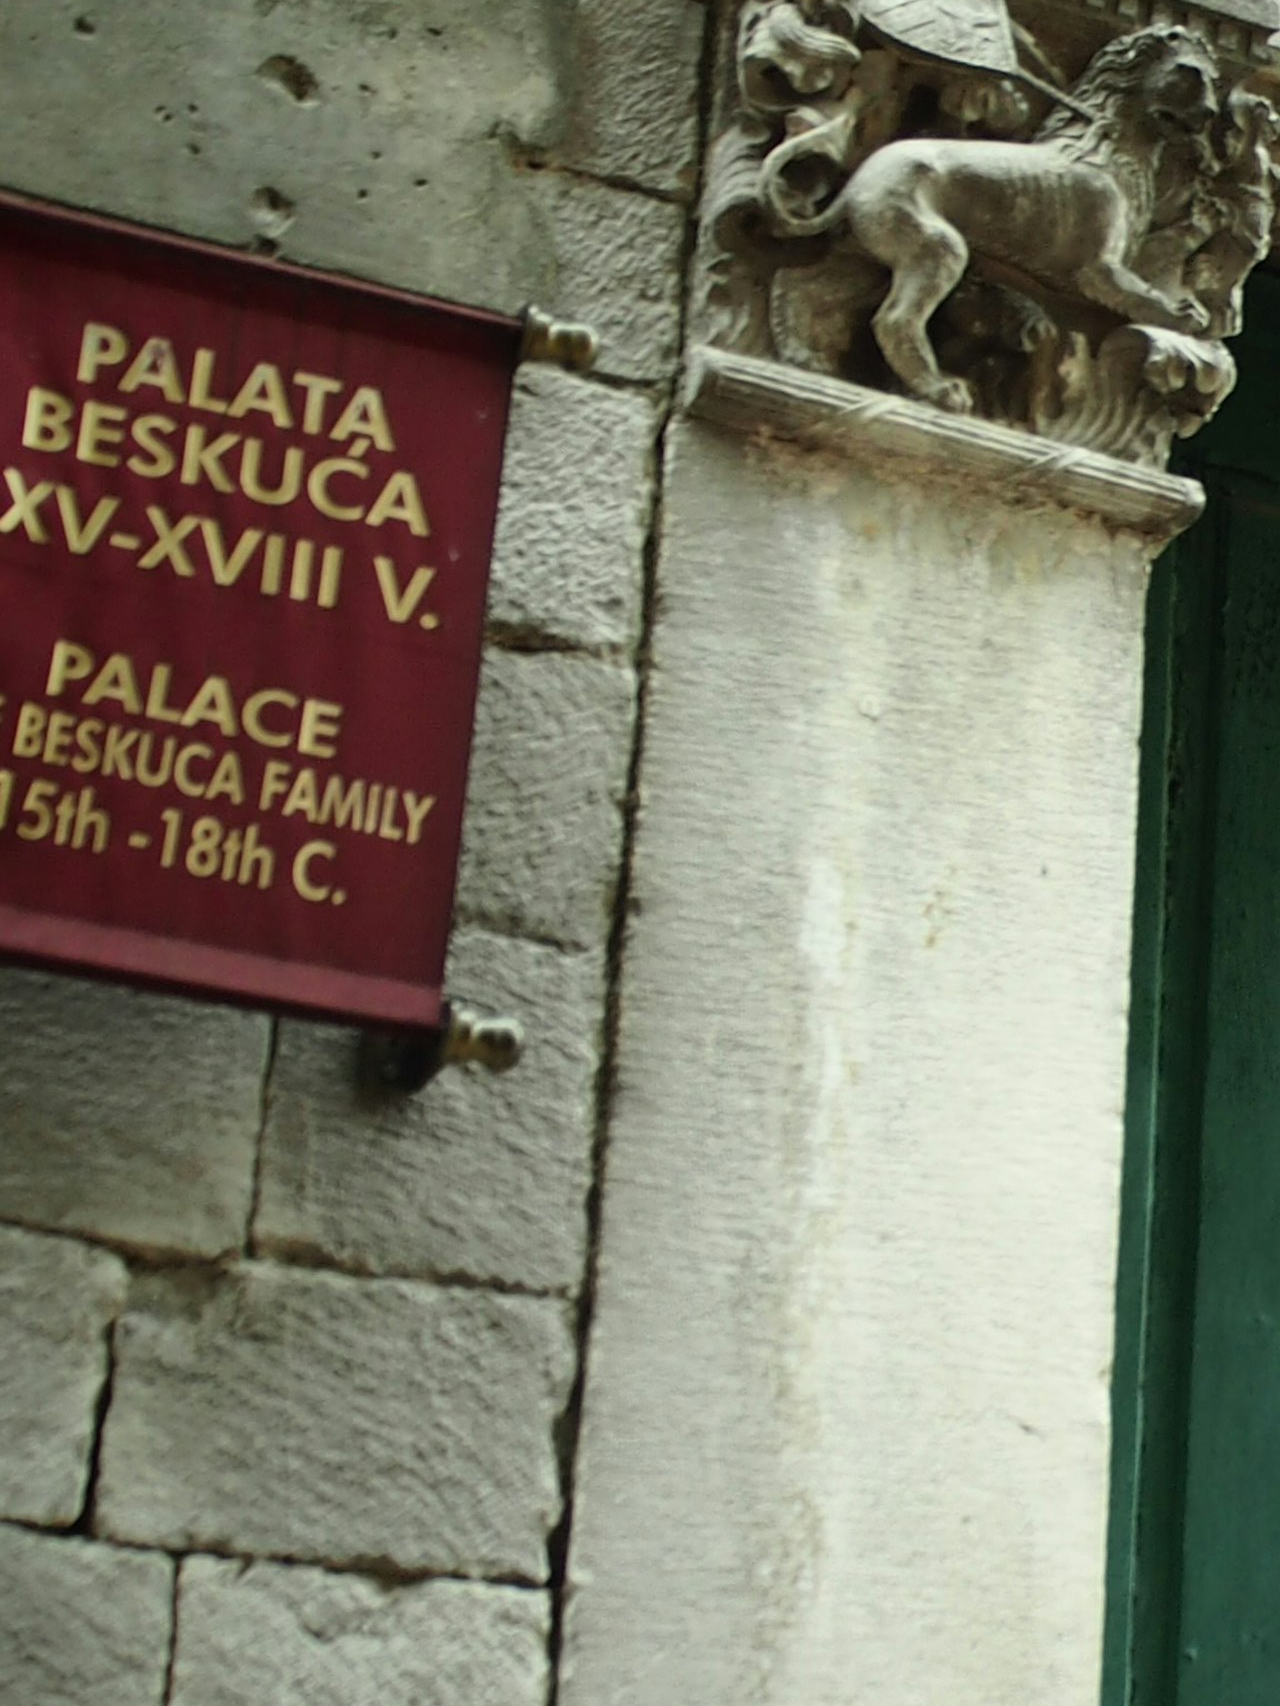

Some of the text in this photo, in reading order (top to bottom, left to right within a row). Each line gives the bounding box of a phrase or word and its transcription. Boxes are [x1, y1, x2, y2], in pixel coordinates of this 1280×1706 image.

[77, 322, 396, 451] PALATA
[22, 385, 430, 537] BESKUĆA
[0, 467, 439, 629] XV-XVIII V.
[46, 638, 343, 759] PALACE
[13, 701, 436, 845] BESKUCA FAMILY
[292, 839, 347, 906] C.
